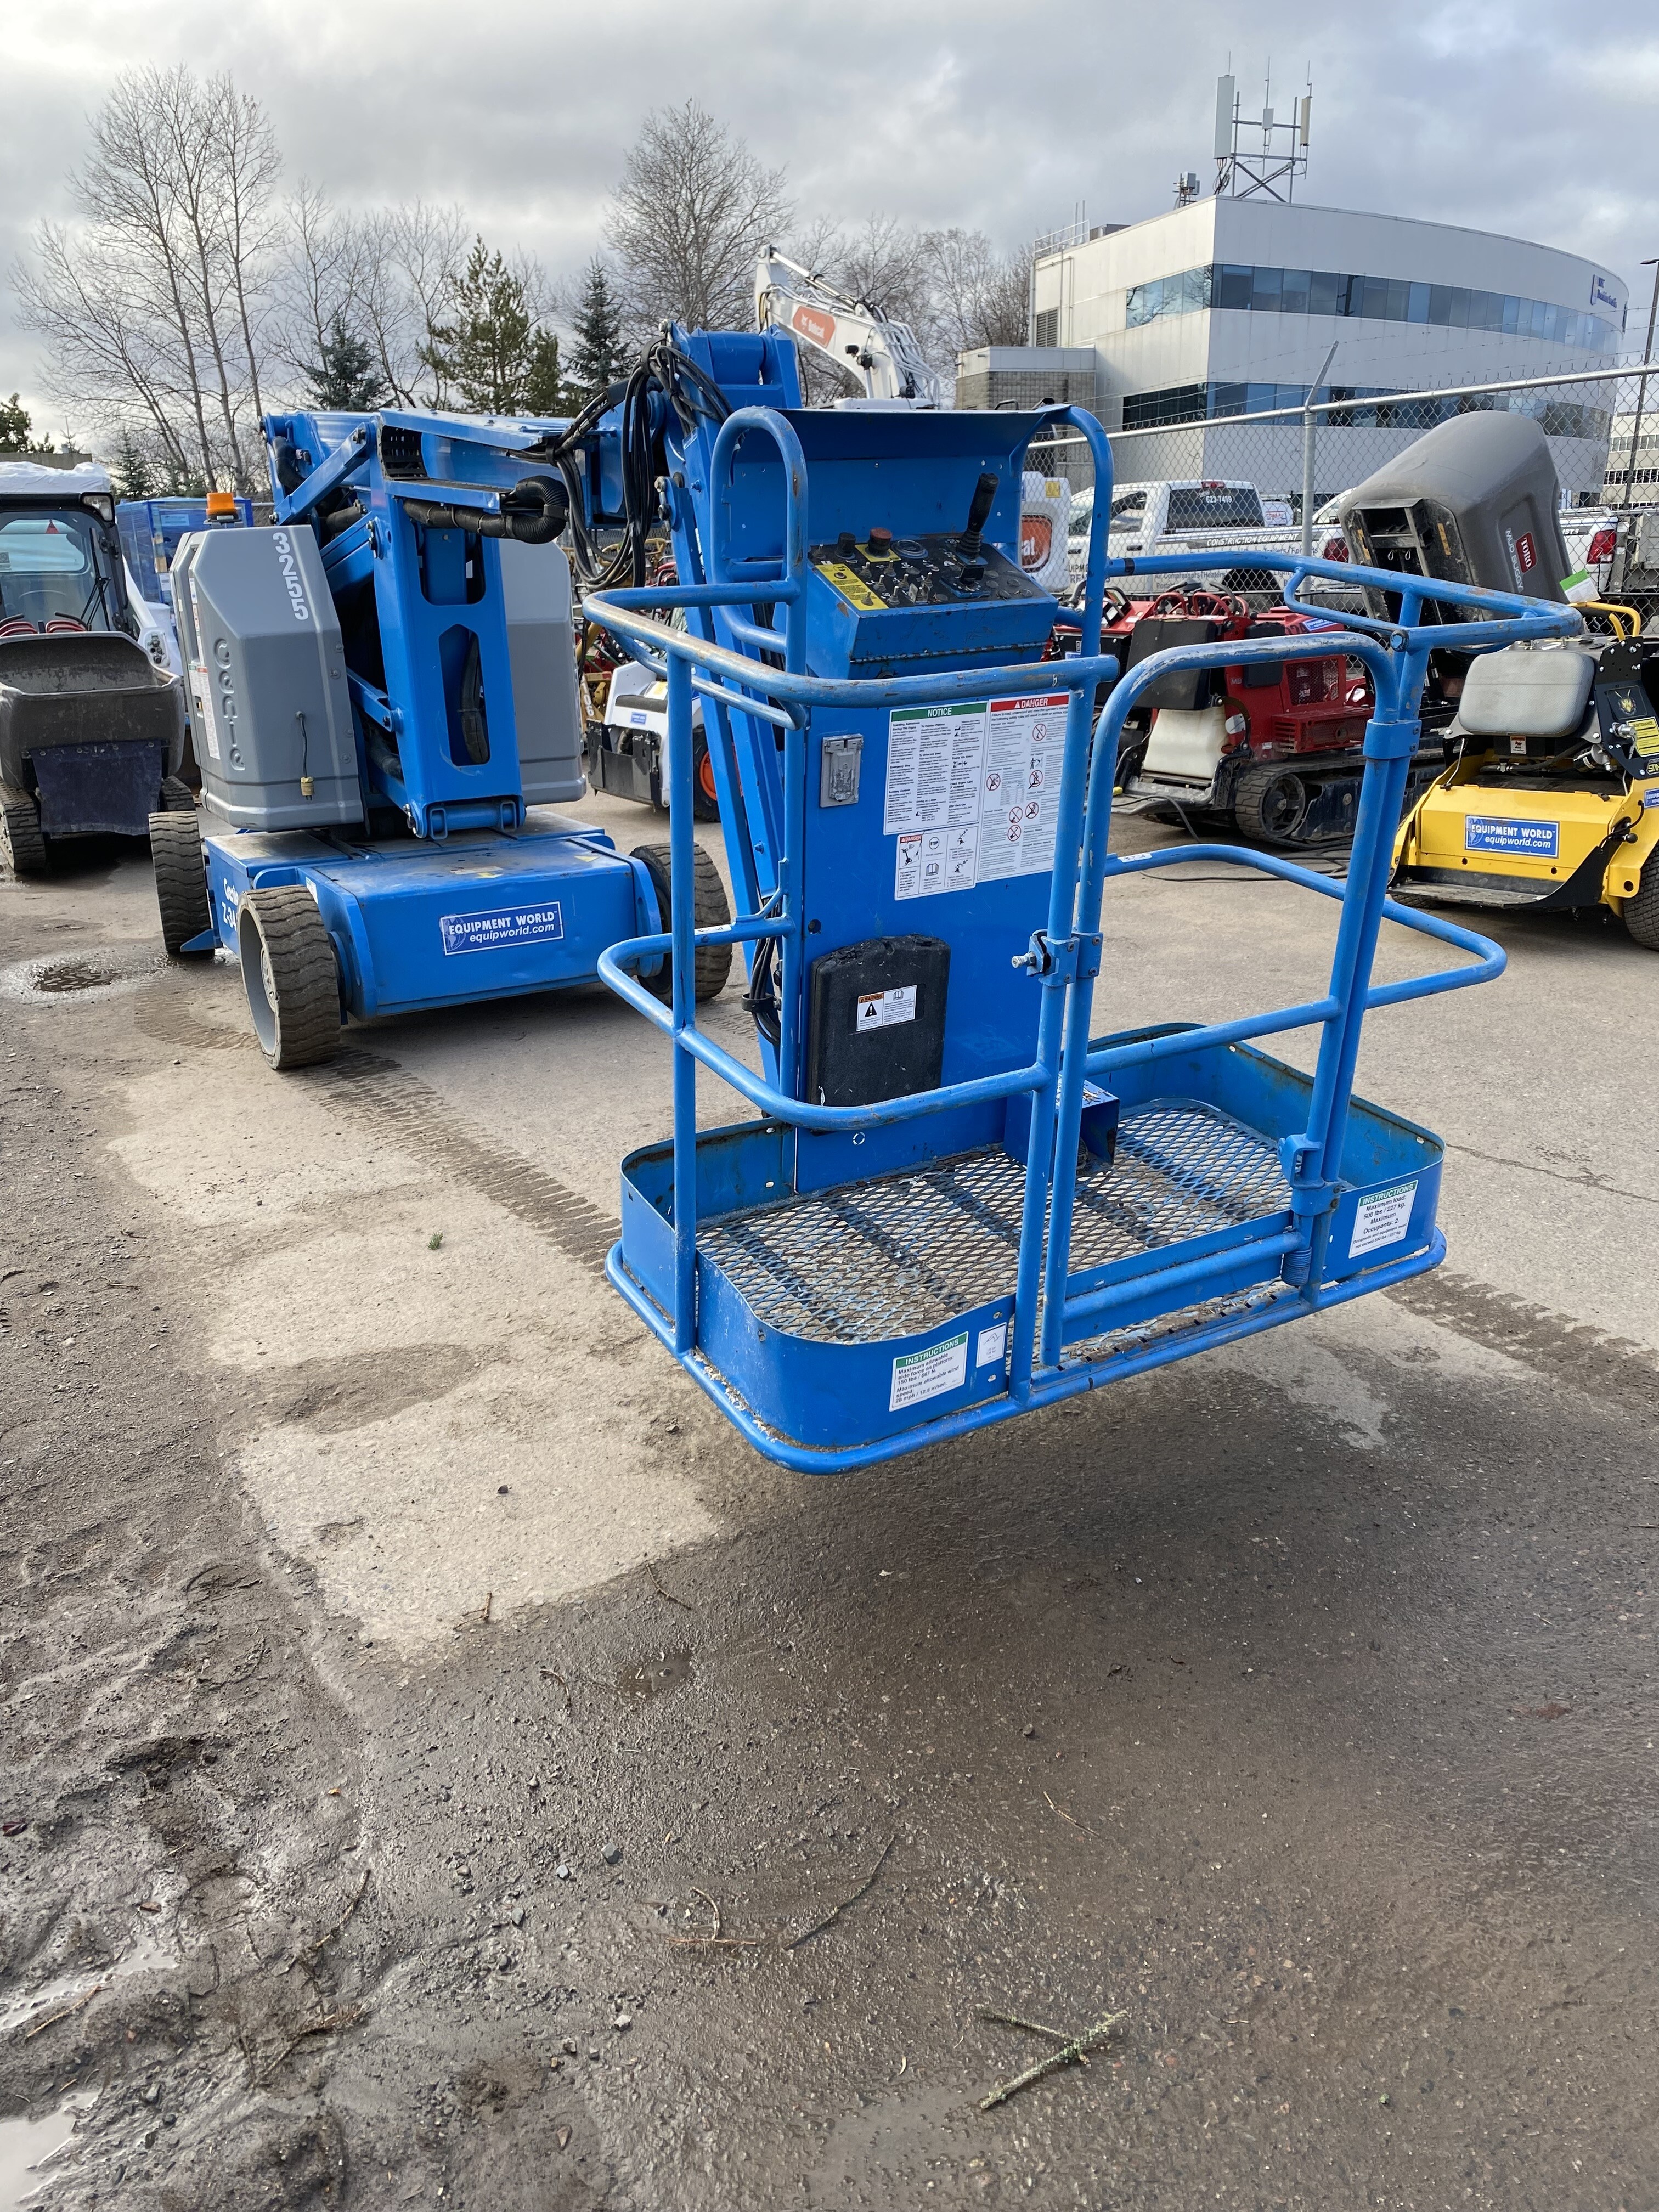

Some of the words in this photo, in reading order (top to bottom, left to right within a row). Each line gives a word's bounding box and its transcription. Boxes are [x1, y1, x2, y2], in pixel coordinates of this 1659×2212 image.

[1258, 533, 1300, 543] EQUIPMENT
[1506, 529, 1515, 553] MUD
[1521, 537, 1533, 568] TORO
[273, 532, 309, 620] 3255
[1511, 555, 1524, 589] BUGGY
[927, 707, 952, 718] NOTICE
[1021, 698, 1048, 708] DANGER
[1471, 823, 1518, 837] EQUIPMENT
[1521, 828, 1553, 839] WORLD
[1485, 836, 1551, 848] equipworld.com
[449, 917, 511, 935] EQUIPMENT
[515, 911, 555, 926] WORLD
[469, 923, 555, 944] equipworld.com
[1363, 1183, 1414, 1205] INSTRUCTIONS
[1366, 1200, 1392, 1211] Maximum
[1393, 1194, 1407, 1203] load:
[1363, 1221, 1393, 1234] Occupants:
[1370, 1212, 1396, 1224] Maximum
[905, 1339, 959, 1365] INSTRUCTIONS
[898, 1363, 924, 1375] Maximum
[926, 1353, 948, 1366] allowable
[896, 1381, 923, 1393] Maximum
[923, 1371, 946, 1384] allowable
[947, 1365, 960, 1374] wind
[896, 1389, 914, 1398] speed:
